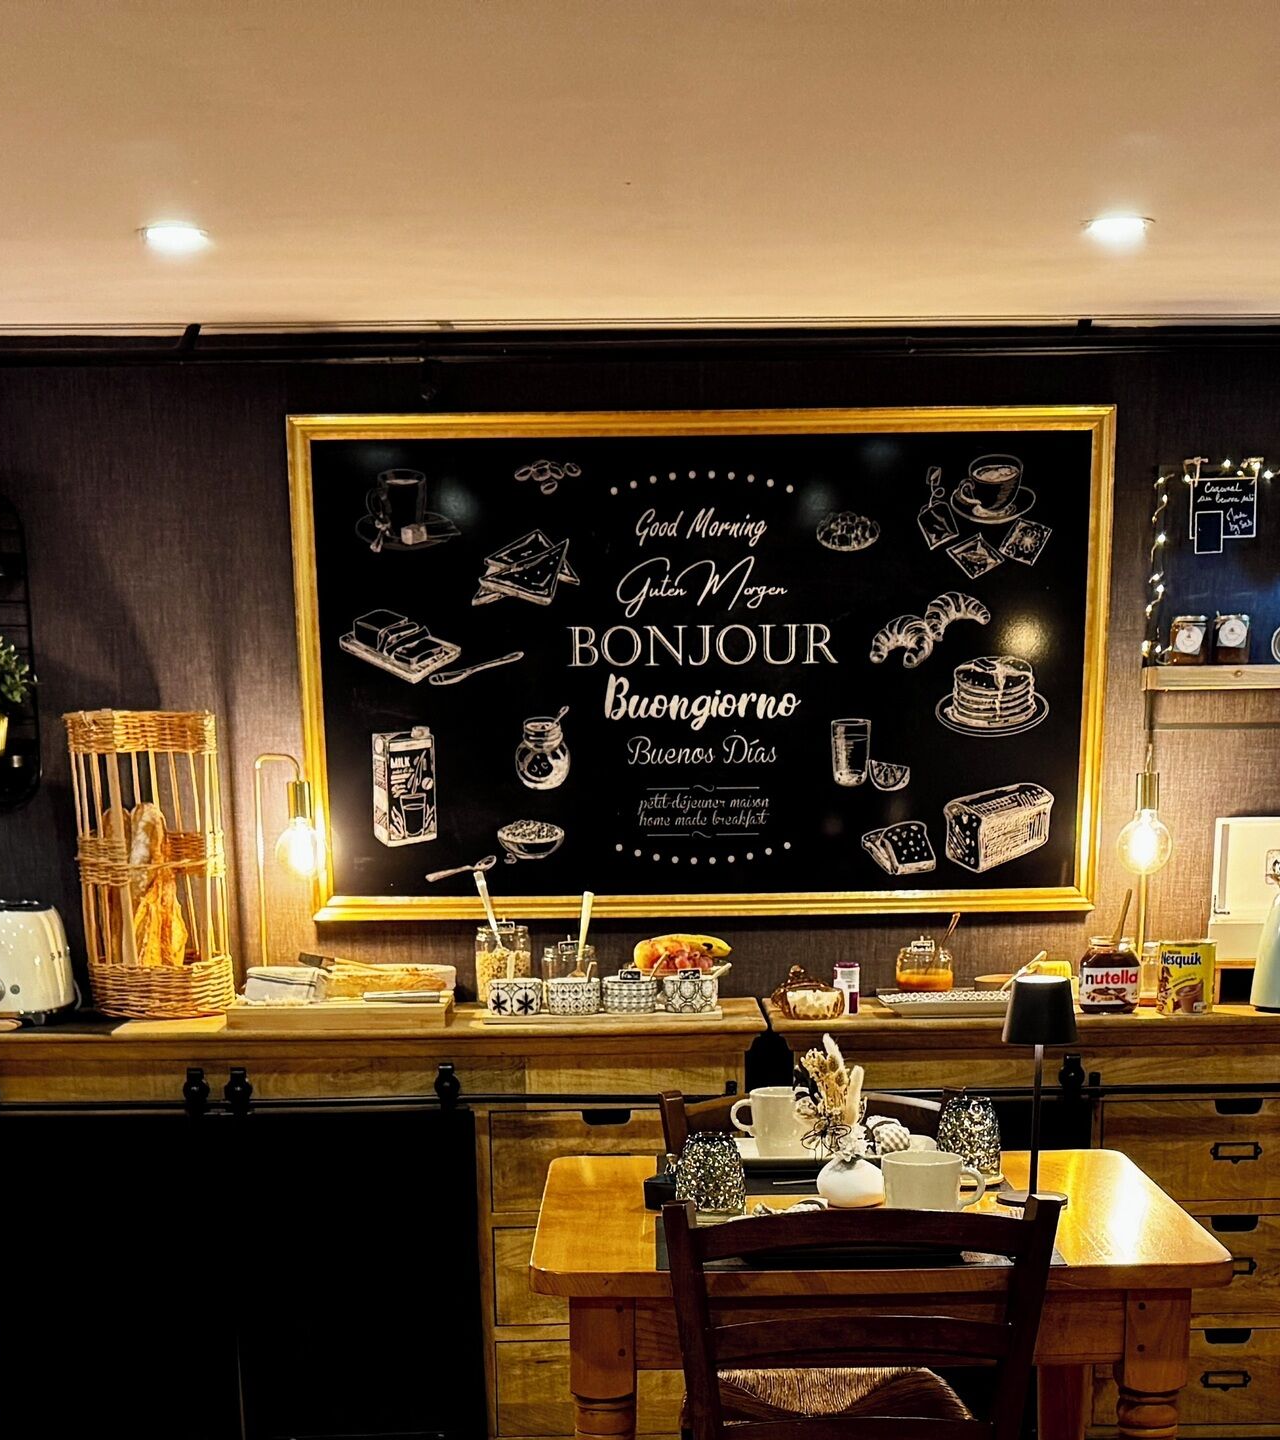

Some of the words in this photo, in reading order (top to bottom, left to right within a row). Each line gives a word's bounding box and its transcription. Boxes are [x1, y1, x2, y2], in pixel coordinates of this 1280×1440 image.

[635, 508, 684, 546] Good
[686, 507, 767, 547] Morning
[617, 557, 687, 618] Guten
[675, 556, 788, 611] Morgen
[566, 623, 839, 667] BONJOUR
[604, 673, 801, 731] Buongiorno
[390, 756, 411, 769] MILK
[627, 736, 715, 765] Buenos
[722, 734, 777, 764] Días
[637, 793, 726, 815] petit-déjeuner
[730, 795, 770, 809] maison
[639, 811, 670, 827] home
[674, 810, 707, 826] made
[712, 809, 770, 828] breakfast
[1161, 952, 1201, 968] Nesquik
[1085, 969, 1138, 985] nutella
